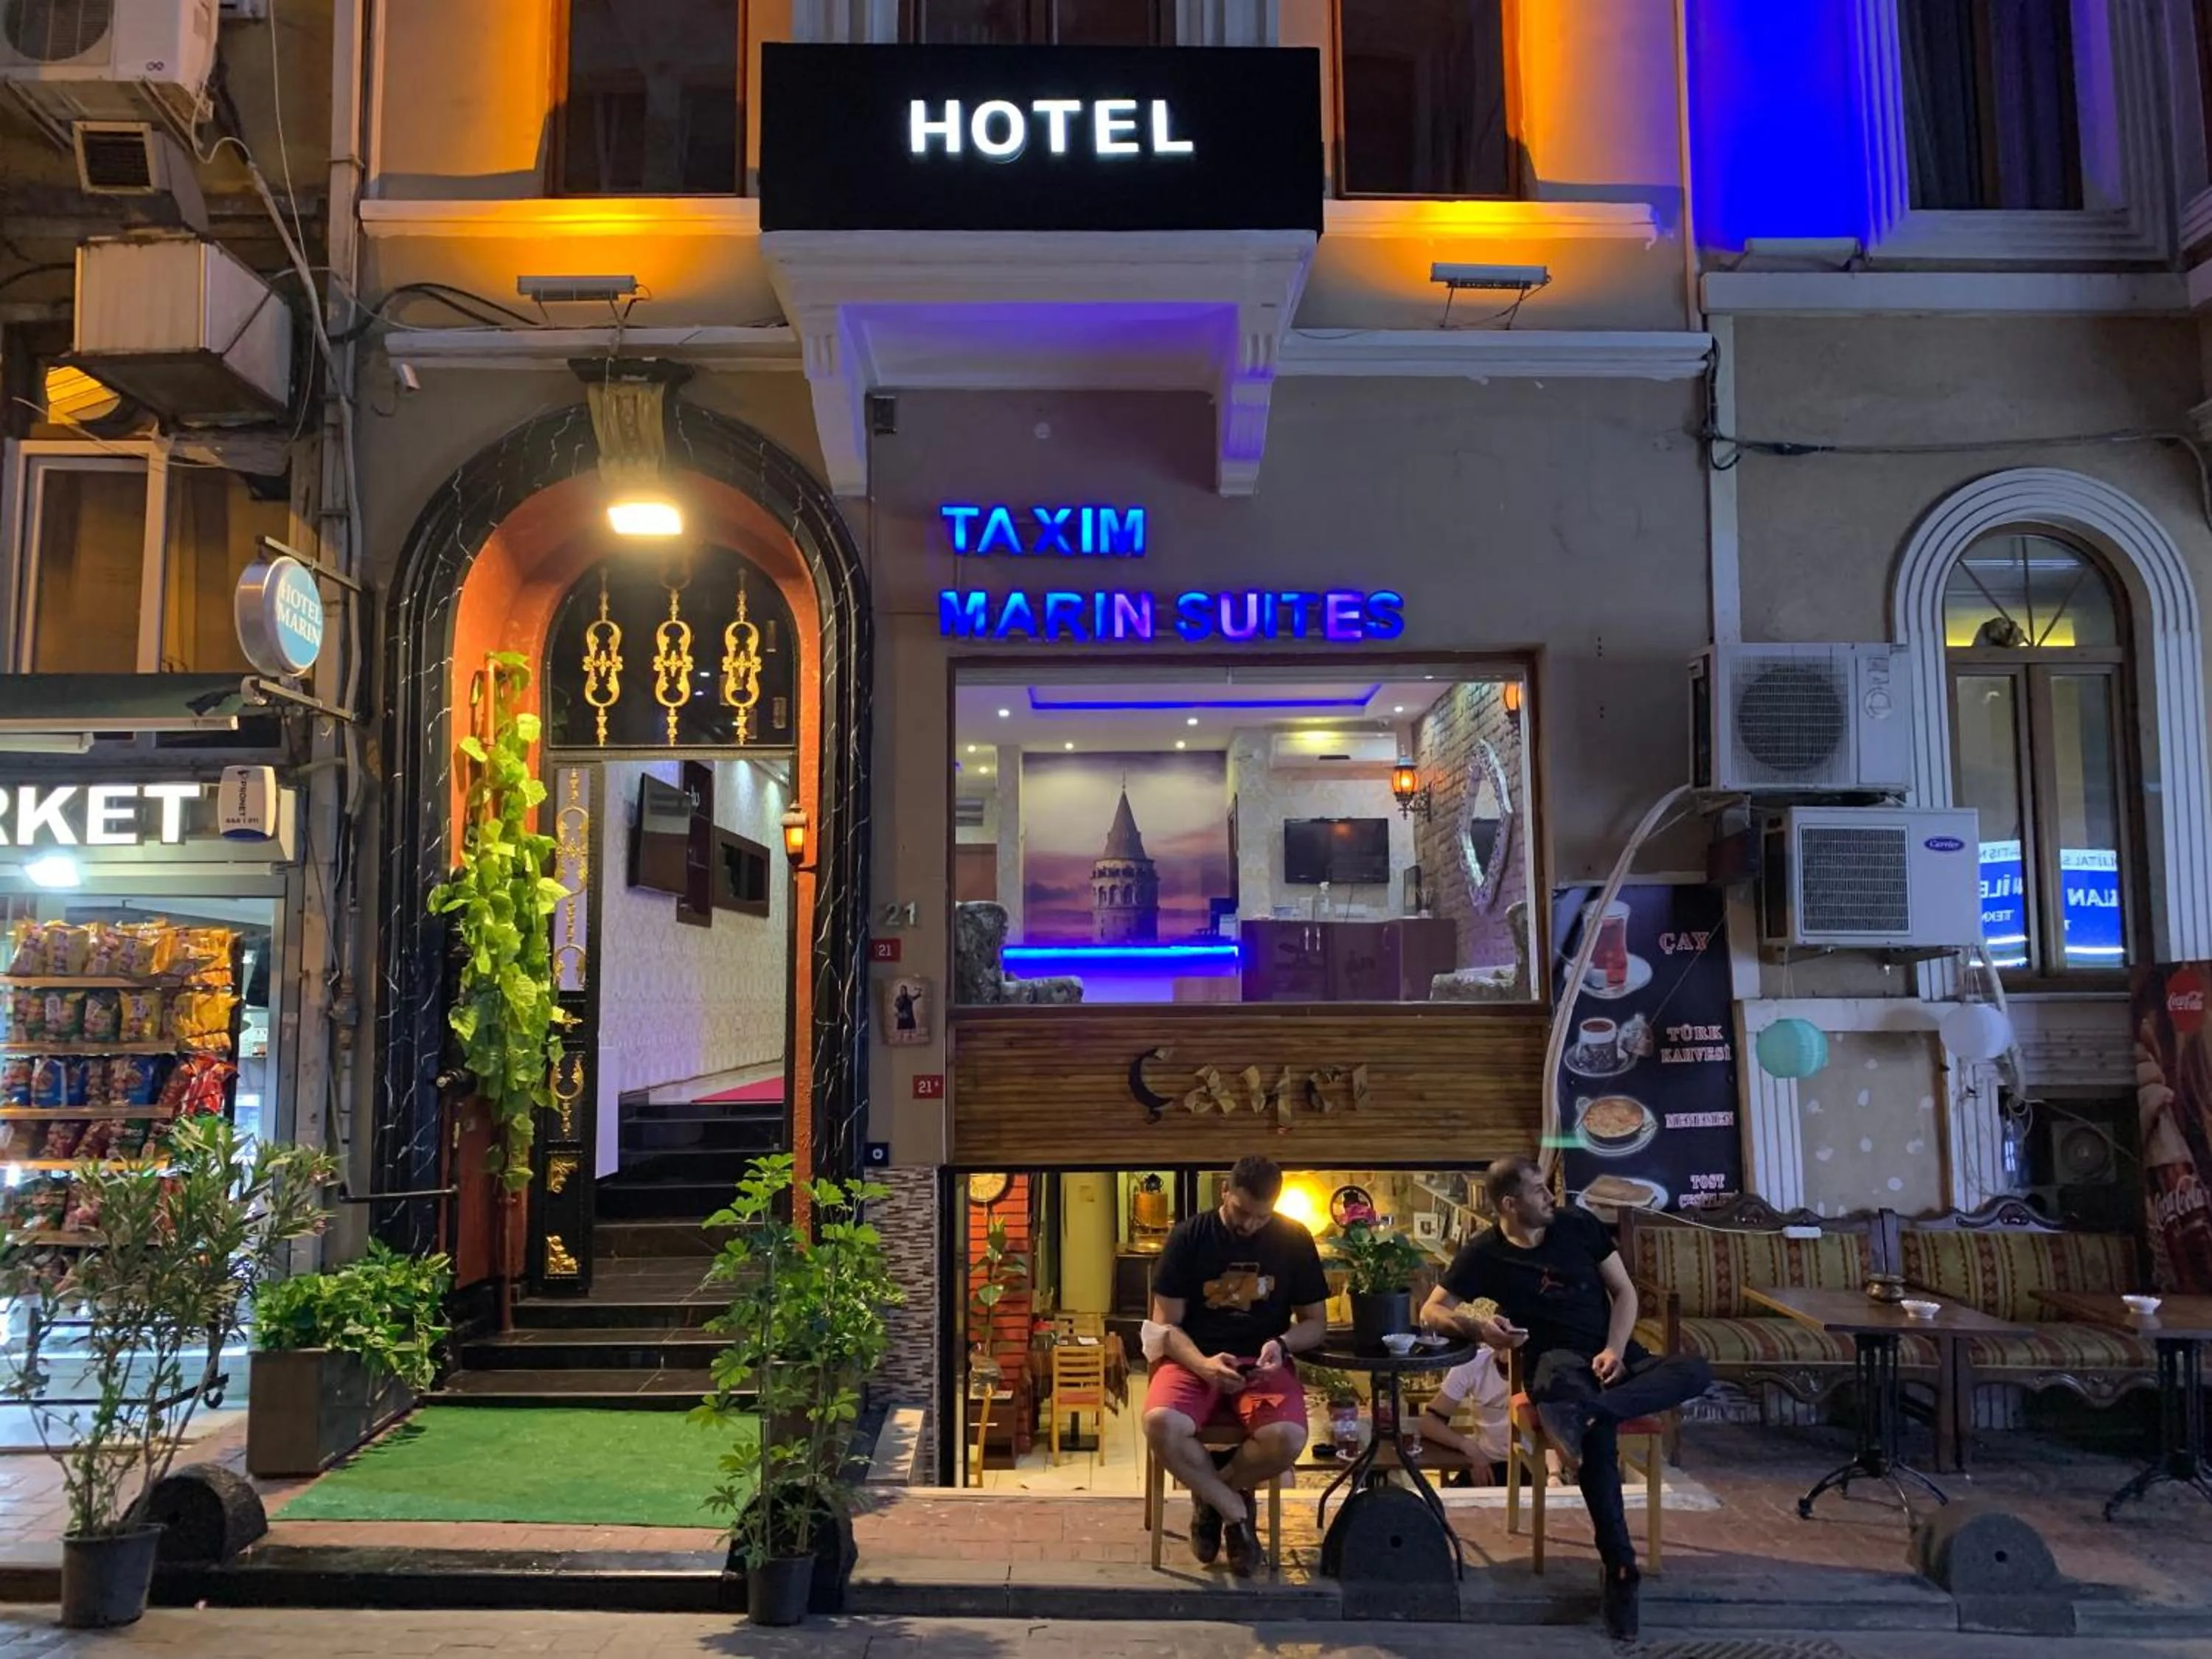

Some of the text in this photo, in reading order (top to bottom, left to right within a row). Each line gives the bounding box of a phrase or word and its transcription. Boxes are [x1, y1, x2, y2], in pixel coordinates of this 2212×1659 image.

[910, 99, 1194, 156] HOTEL
[940, 506, 1147, 556] TAXIM
[280, 581, 321, 625] HOTEL
[939, 591, 1405, 640] MARIN SUITES
[277, 600, 321, 647] MARIN
[0, 785, 201, 846] KET
[885, 902, 916, 926] 21
[878, 944, 891, 956] 21
[1659, 931, 1709, 955] ÇAY
[1666, 1023, 1723, 1043] TÜRK
[1661, 1044, 1732, 1063] KAHVESİ
[1689, 1173, 1725, 1189] TOST
